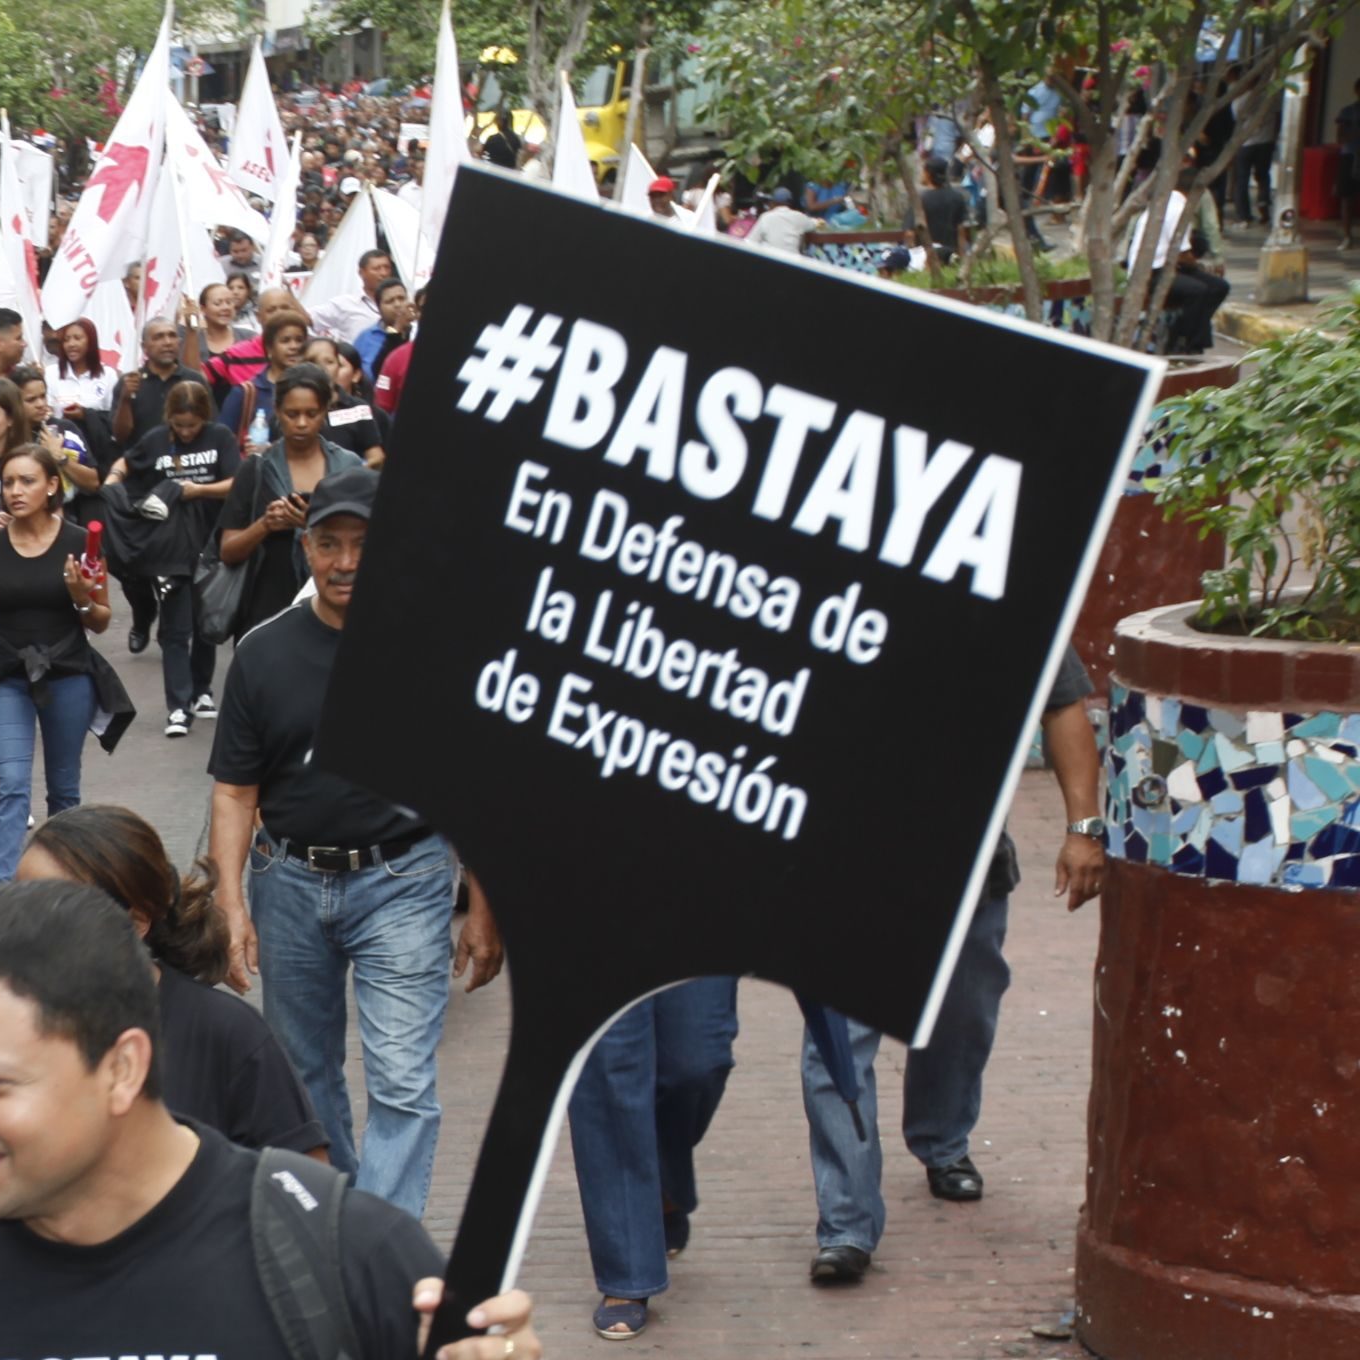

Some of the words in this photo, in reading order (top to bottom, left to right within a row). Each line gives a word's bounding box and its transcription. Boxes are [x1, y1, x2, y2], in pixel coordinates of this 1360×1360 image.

[455, 303, 1023, 600] #BASTAYA
[504, 461, 570, 544] En
[581, 488, 800, 633] Defensa
[809, 582, 888, 665] de
[525, 566, 576, 643] la
[583, 590, 811, 738] Libertad
[475, 650, 541, 725] de
[547, 672, 808, 842] Expresión
